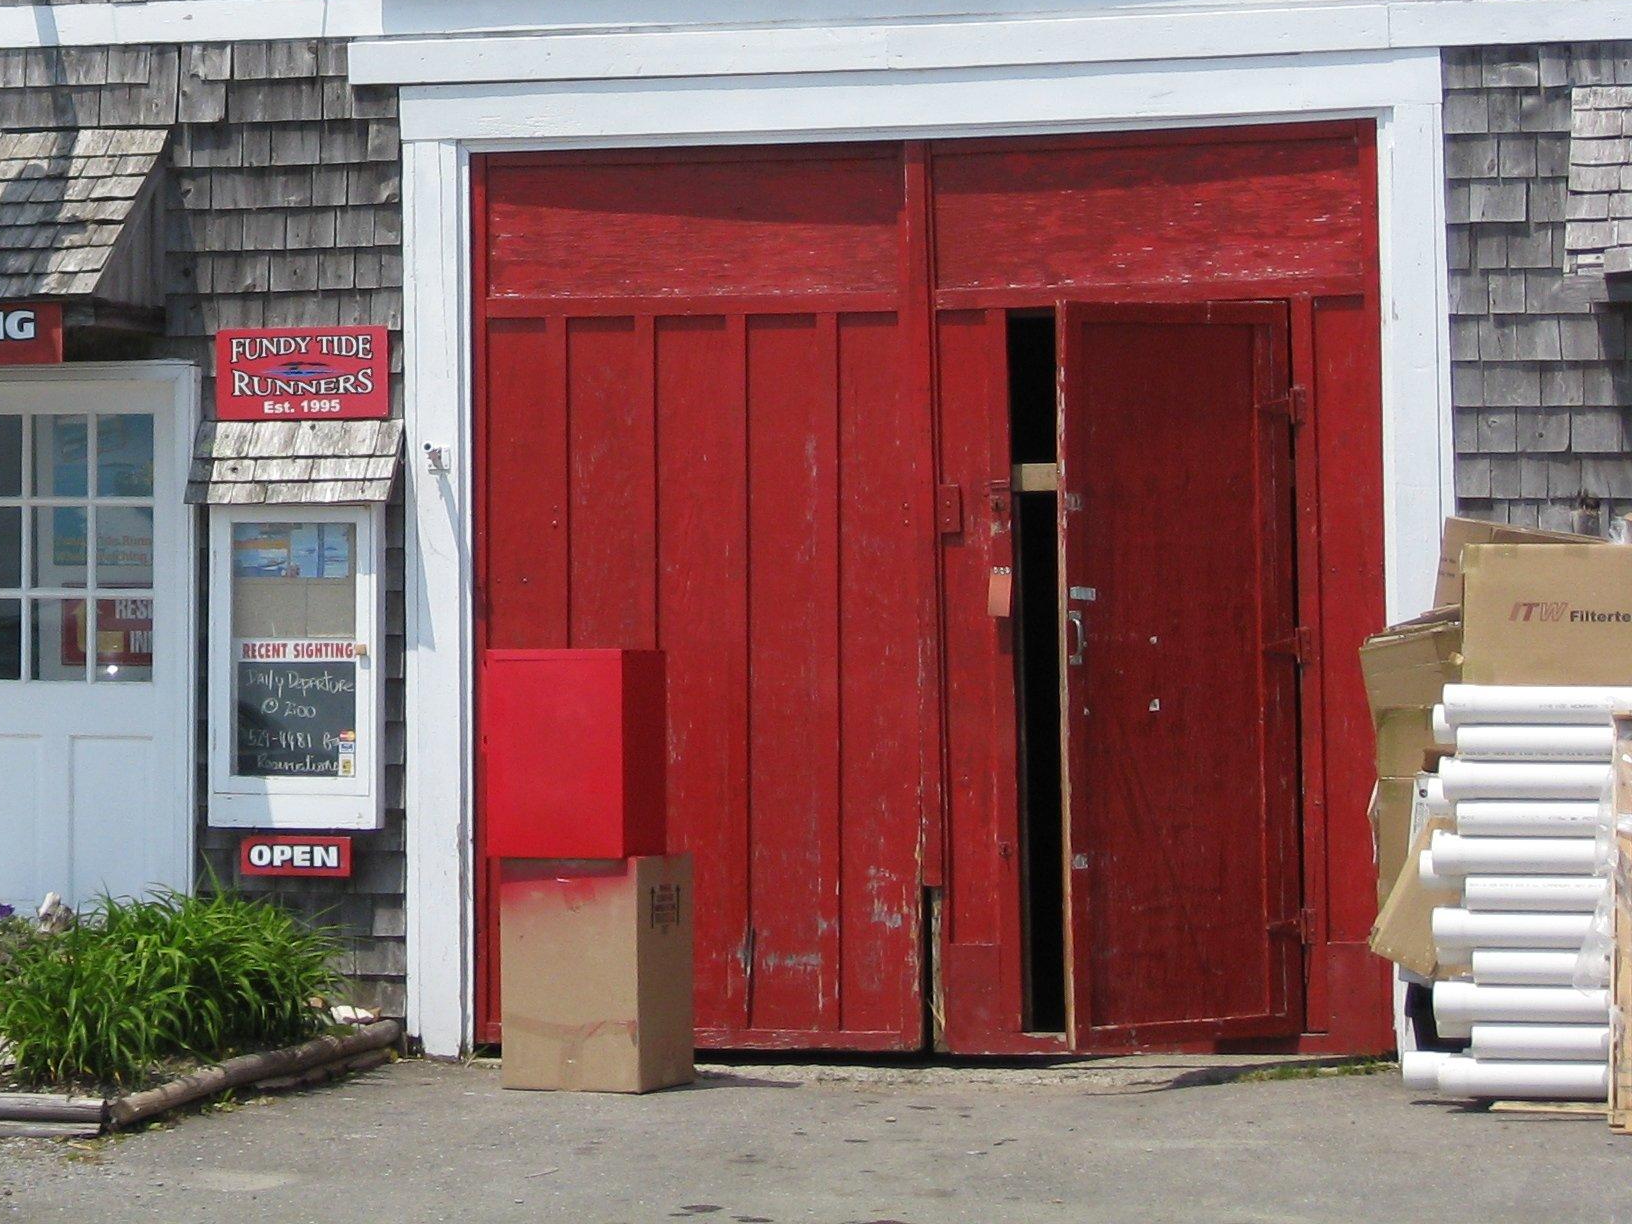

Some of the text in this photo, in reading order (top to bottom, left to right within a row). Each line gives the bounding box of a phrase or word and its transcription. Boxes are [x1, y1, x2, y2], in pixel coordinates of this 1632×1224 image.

[230, 335, 373, 363] FUNDY TIDE
[232, 368, 374, 396] RUNNERS
[263, 399, 341, 414] Est. 1995
[1508, 601, 1632, 623] ITW Filterte
[242, 642, 356, 659] RECENT SIGHTING
[250, 844, 338, 867] OPEN
